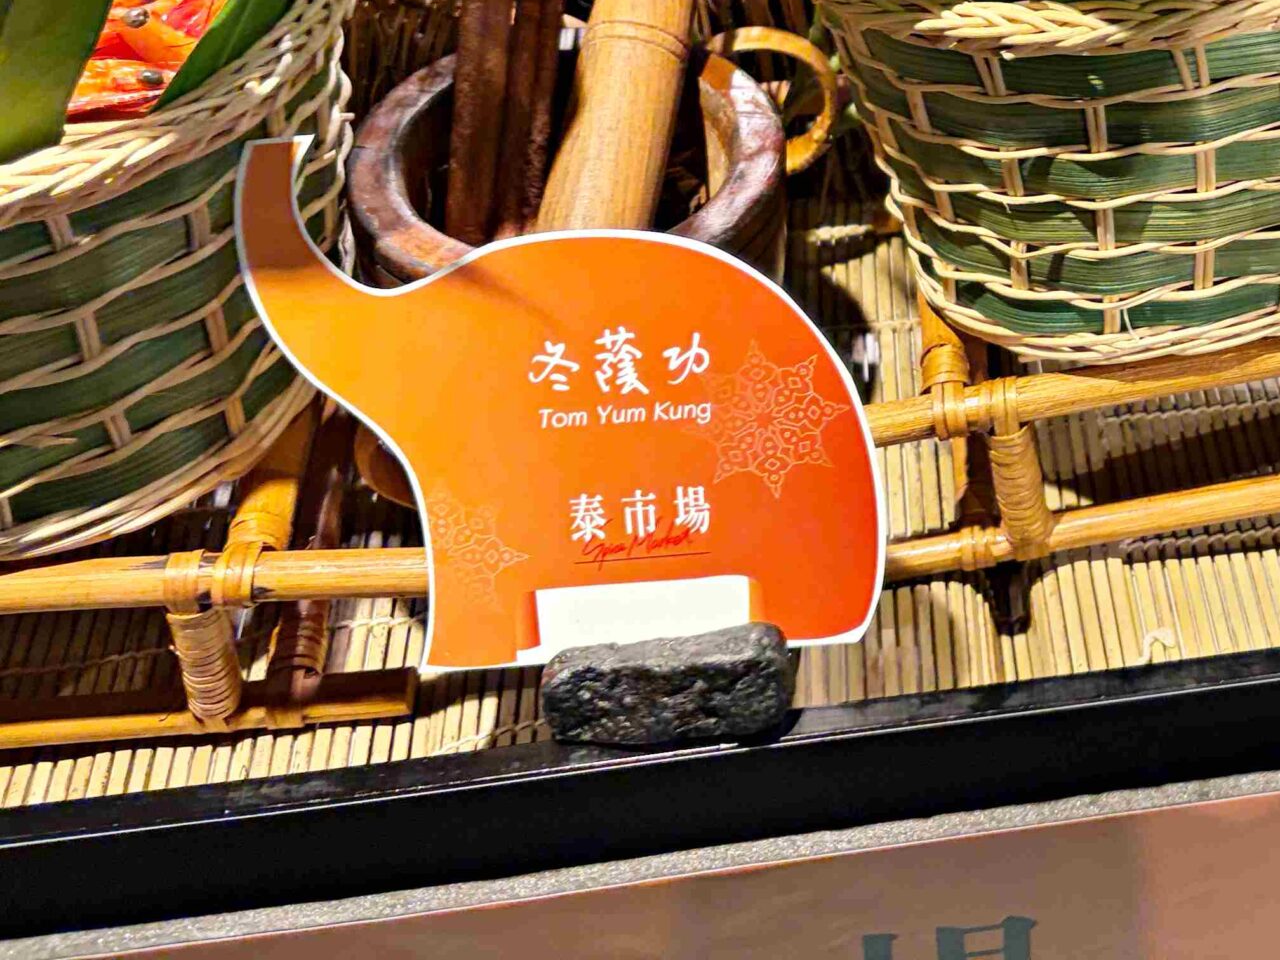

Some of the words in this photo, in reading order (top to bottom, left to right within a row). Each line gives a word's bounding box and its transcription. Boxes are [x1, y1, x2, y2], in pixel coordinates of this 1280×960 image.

[528, 326, 710, 395] 冬蔭功
[538, 408, 588, 429] Tom
[596, 404, 646, 425] Yum
[653, 401, 712, 425] Kung
[568, 485, 711, 542] 泰市場
